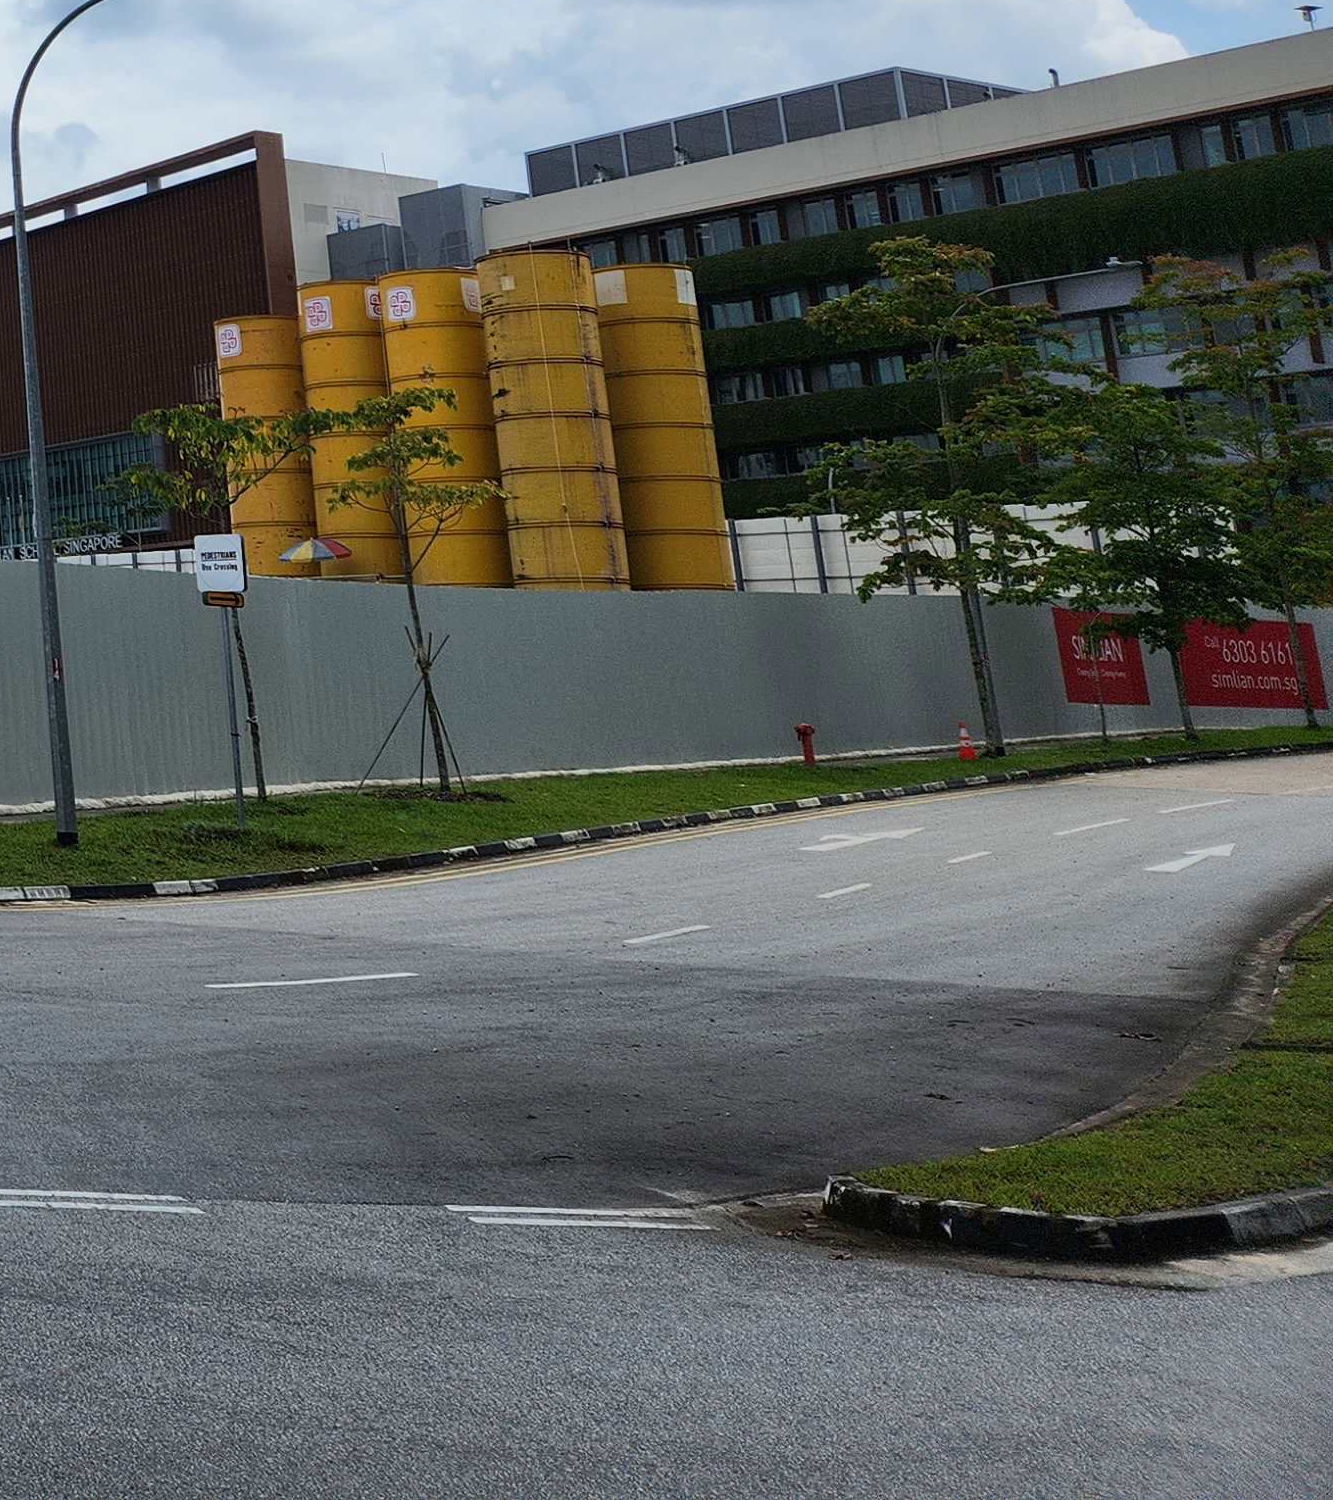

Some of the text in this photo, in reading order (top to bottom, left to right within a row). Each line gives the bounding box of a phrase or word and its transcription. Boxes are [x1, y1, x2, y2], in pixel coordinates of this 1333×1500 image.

[19, 545, 59, 559] SCHL
[63, 535, 123, 554] SINGAPORE
[201, 551, 237, 559] PEDESTRIANS
[214, 563, 238, 571] Crossing
[1223, 639, 1257, 663] 6303
[1261, 641, 1293, 665] 6161
[1213, 669, 1298, 696] simlian.com.sg
